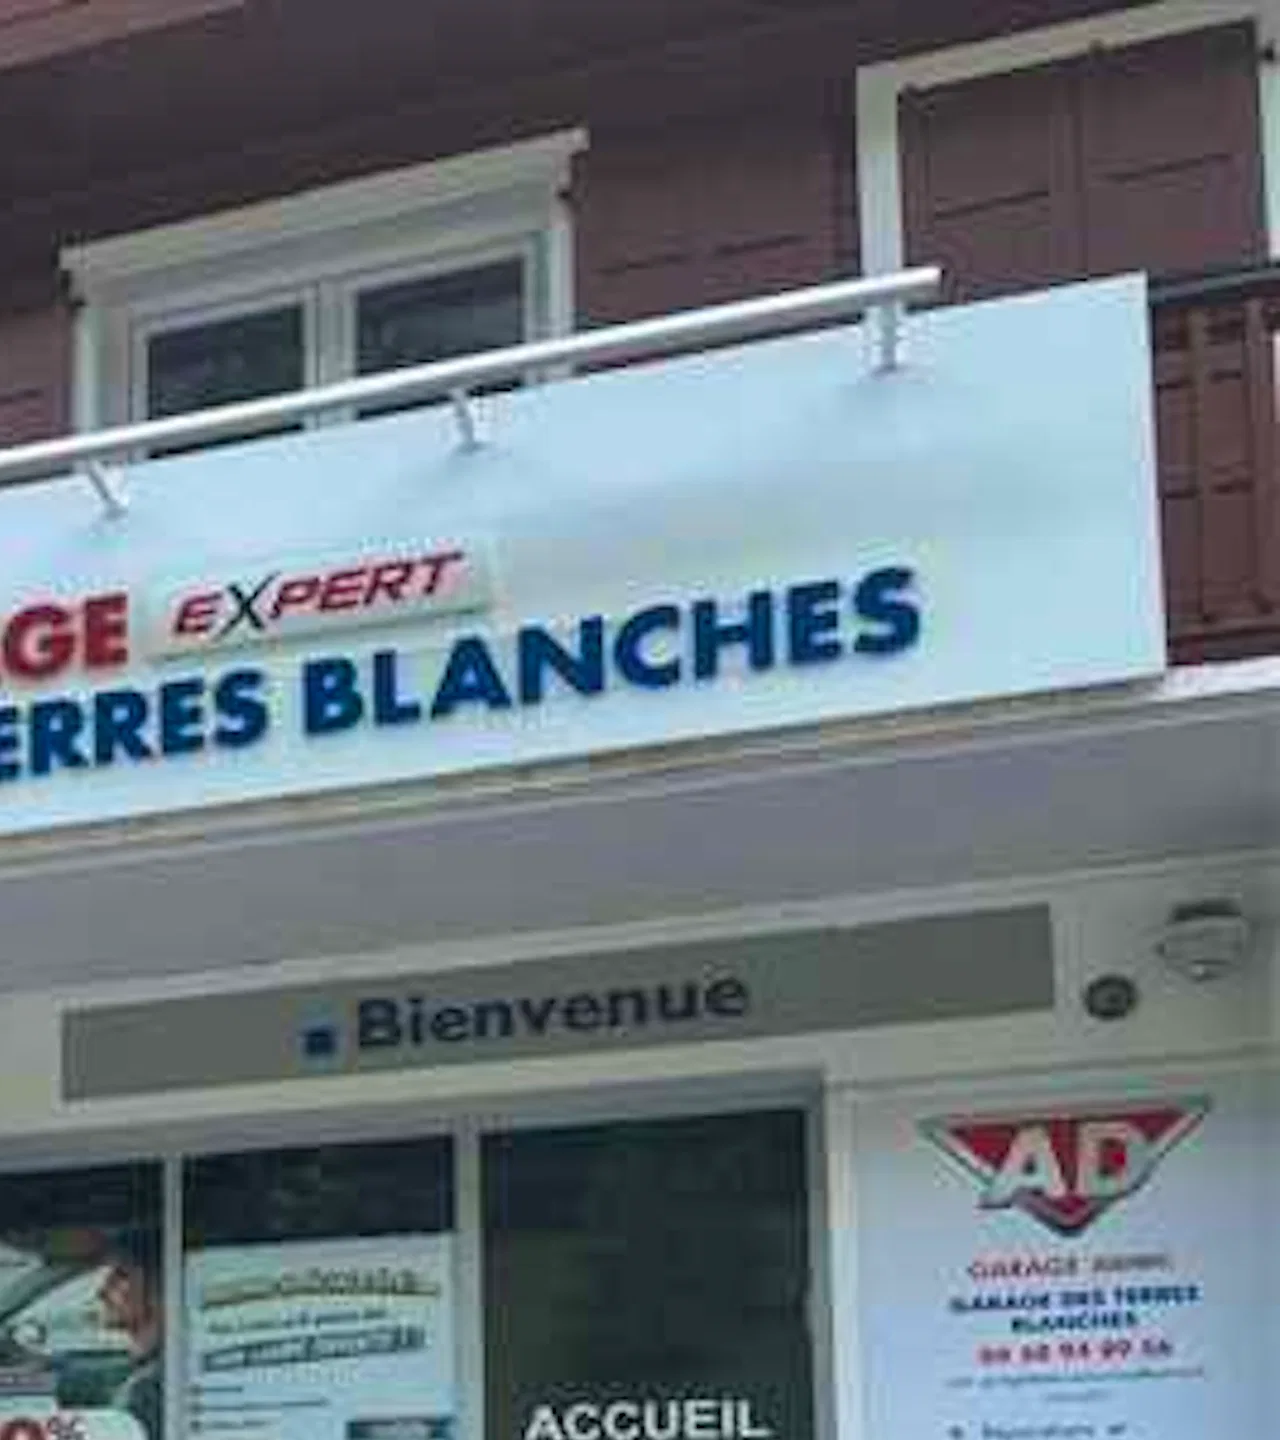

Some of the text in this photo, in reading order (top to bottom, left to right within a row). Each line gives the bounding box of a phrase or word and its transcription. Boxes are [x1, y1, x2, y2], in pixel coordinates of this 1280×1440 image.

[303, 566, 923, 736] BLANCHES
[358, 975, 747, 1047] Bienvenue
[967, 1256, 1079, 1279] GARAGE
[1010, 1310, 1138, 1334] BLANCHES
